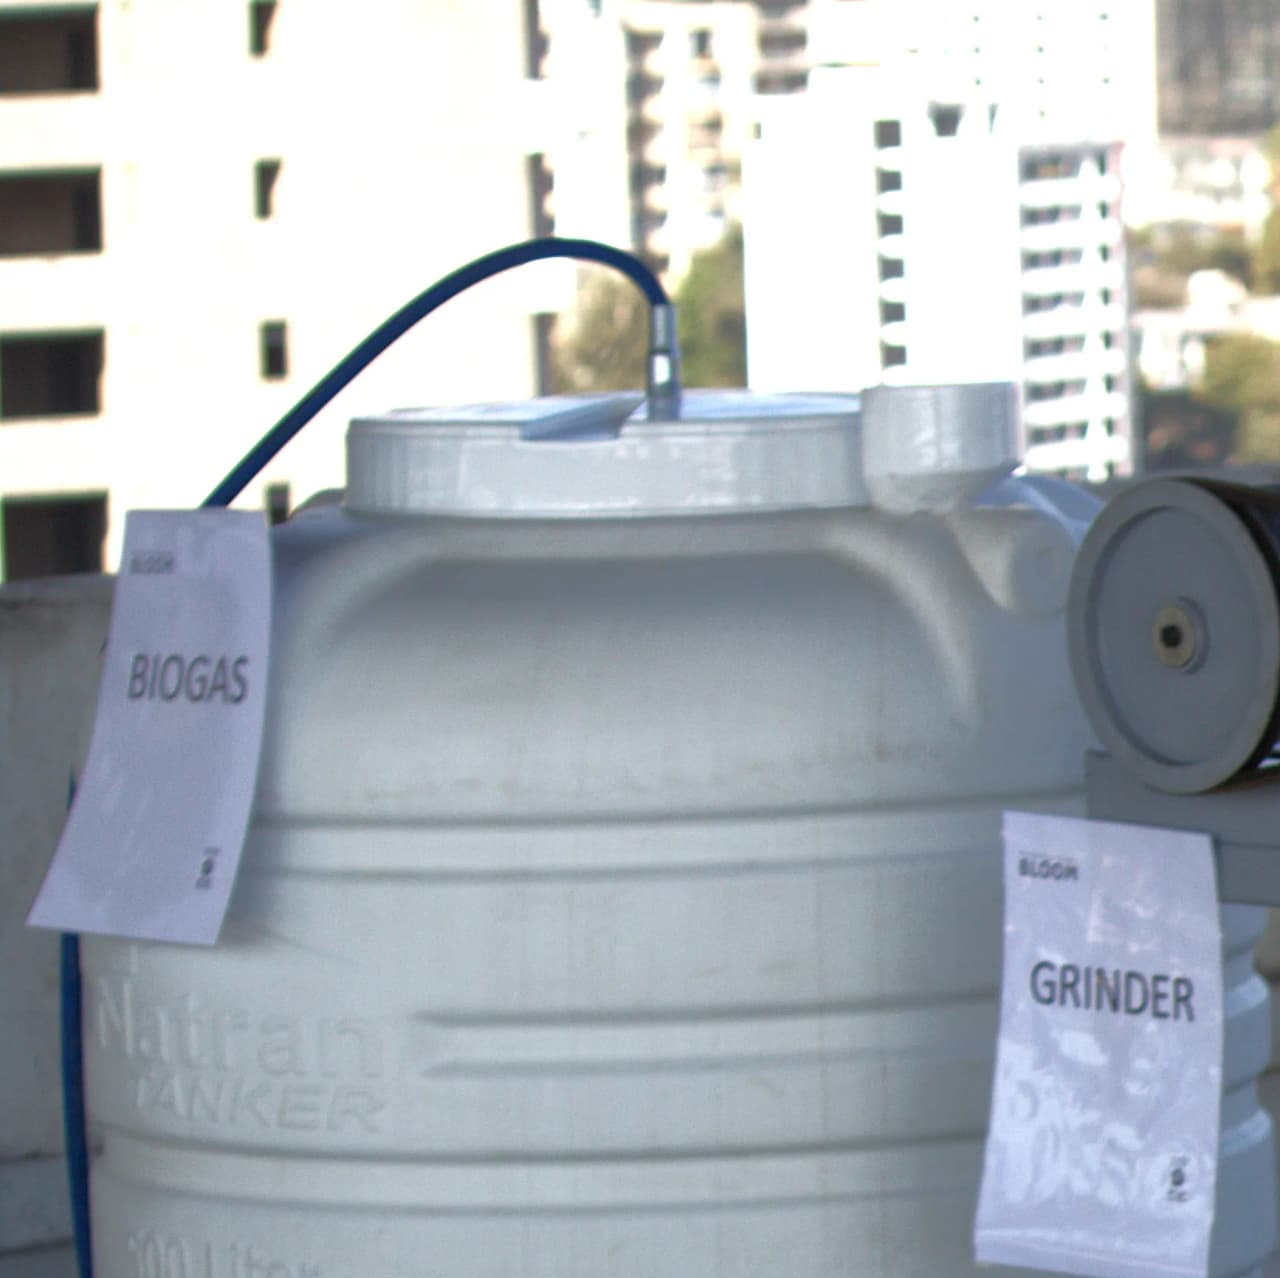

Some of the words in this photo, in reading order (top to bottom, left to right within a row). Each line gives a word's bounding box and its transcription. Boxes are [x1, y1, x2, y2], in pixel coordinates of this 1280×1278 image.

[128, 652, 249, 705] BIOGAS
[1018, 857, 1078, 881] BLOOM
[1029, 961, 1196, 1023] GRINDER
